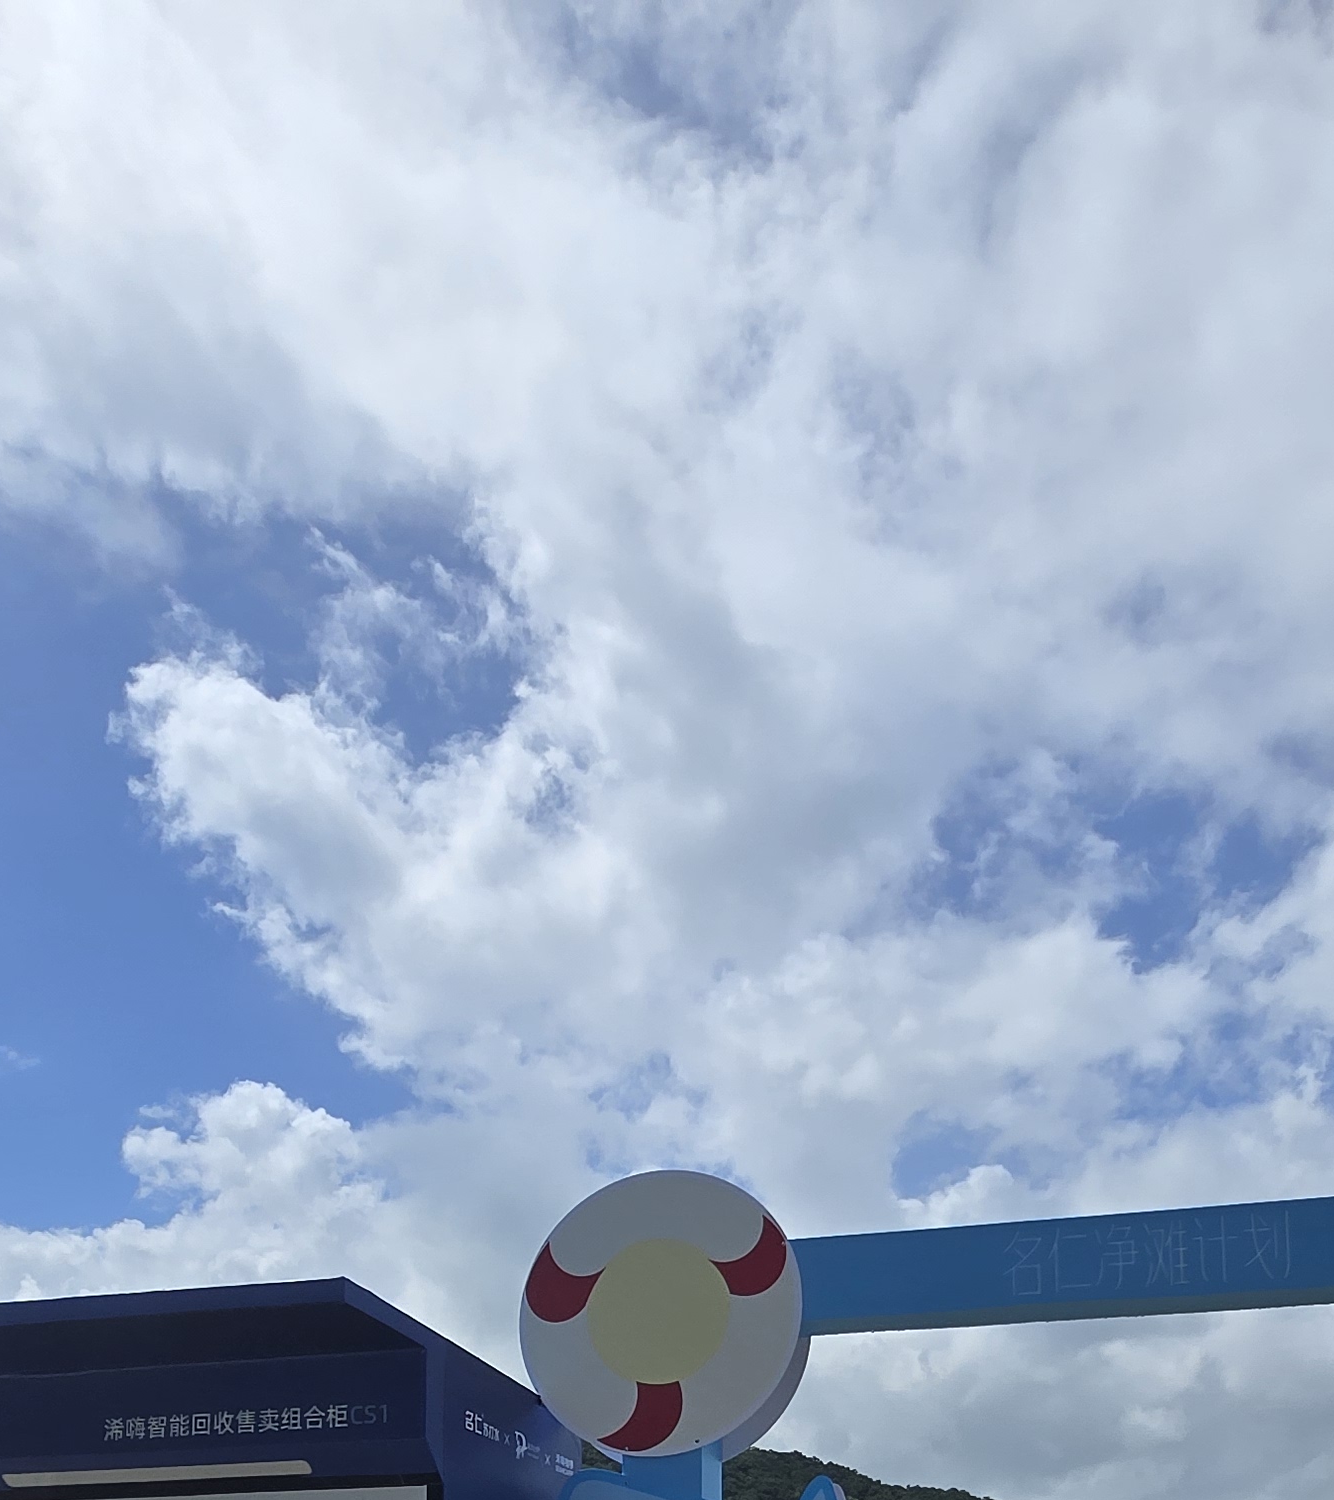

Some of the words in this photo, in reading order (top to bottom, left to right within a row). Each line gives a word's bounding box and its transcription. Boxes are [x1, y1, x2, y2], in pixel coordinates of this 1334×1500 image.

[1004, 1209, 1292, 1297] 名仁净滩计划
